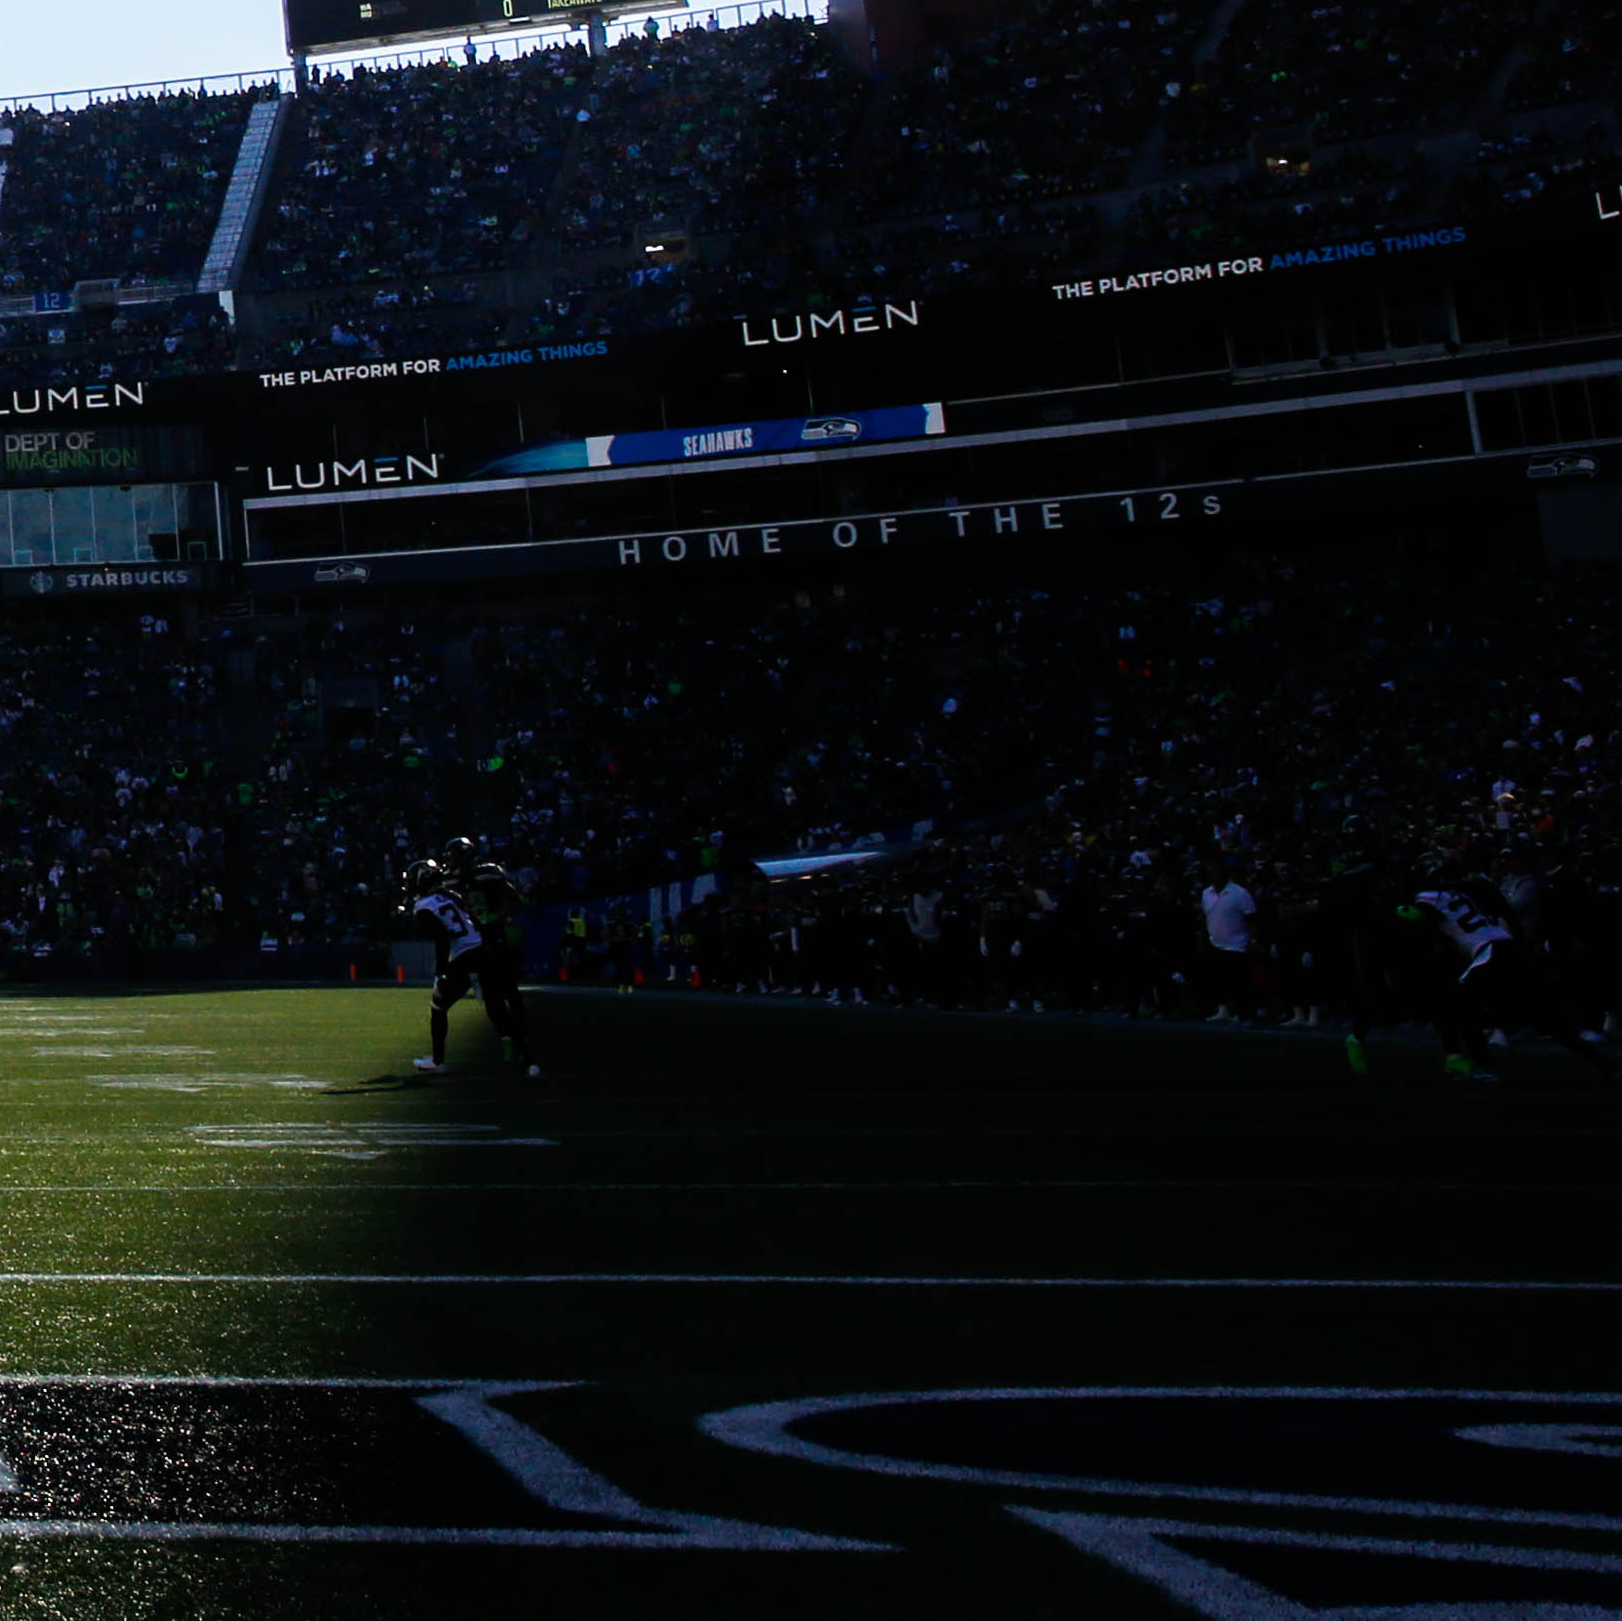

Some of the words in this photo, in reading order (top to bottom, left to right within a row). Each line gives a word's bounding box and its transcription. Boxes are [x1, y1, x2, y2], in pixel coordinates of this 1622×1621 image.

[503, 0, 513, 18] 0
[1596, 185, 1622, 219] L
[1053, 283, 1094, 302] THE
[1099, 263, 1213, 295] PLATFORM
[1218, 257, 1264, 278] FOR
[1269, 239, 1376, 270] AMAZING
[1382, 227, 1466, 255] THINGS
[43, 291, 61, 308] 12
[741, 300, 919, 347] LUMEN
[260, 370, 295, 389] THE
[300, 360, 398, 386] PLATFORM
[402, 357, 441, 376] FOR
[446, 348, 534, 371] AMAZING
[540, 340, 609, 362] THINGS
[5, 432, 59, 452] DEPT
[65, 430, 96, 450] OF
[682, 427, 753, 457] SEAHAWKS
[6, 447, 139, 470] IMAGINATION
[266, 453, 442, 491] LUMEN
[617, 527, 783, 566] HOME
[831, 516, 899, 549] OF
[948, 503, 1064, 538] THE
[66, 570, 189, 588] STARBUCKS
